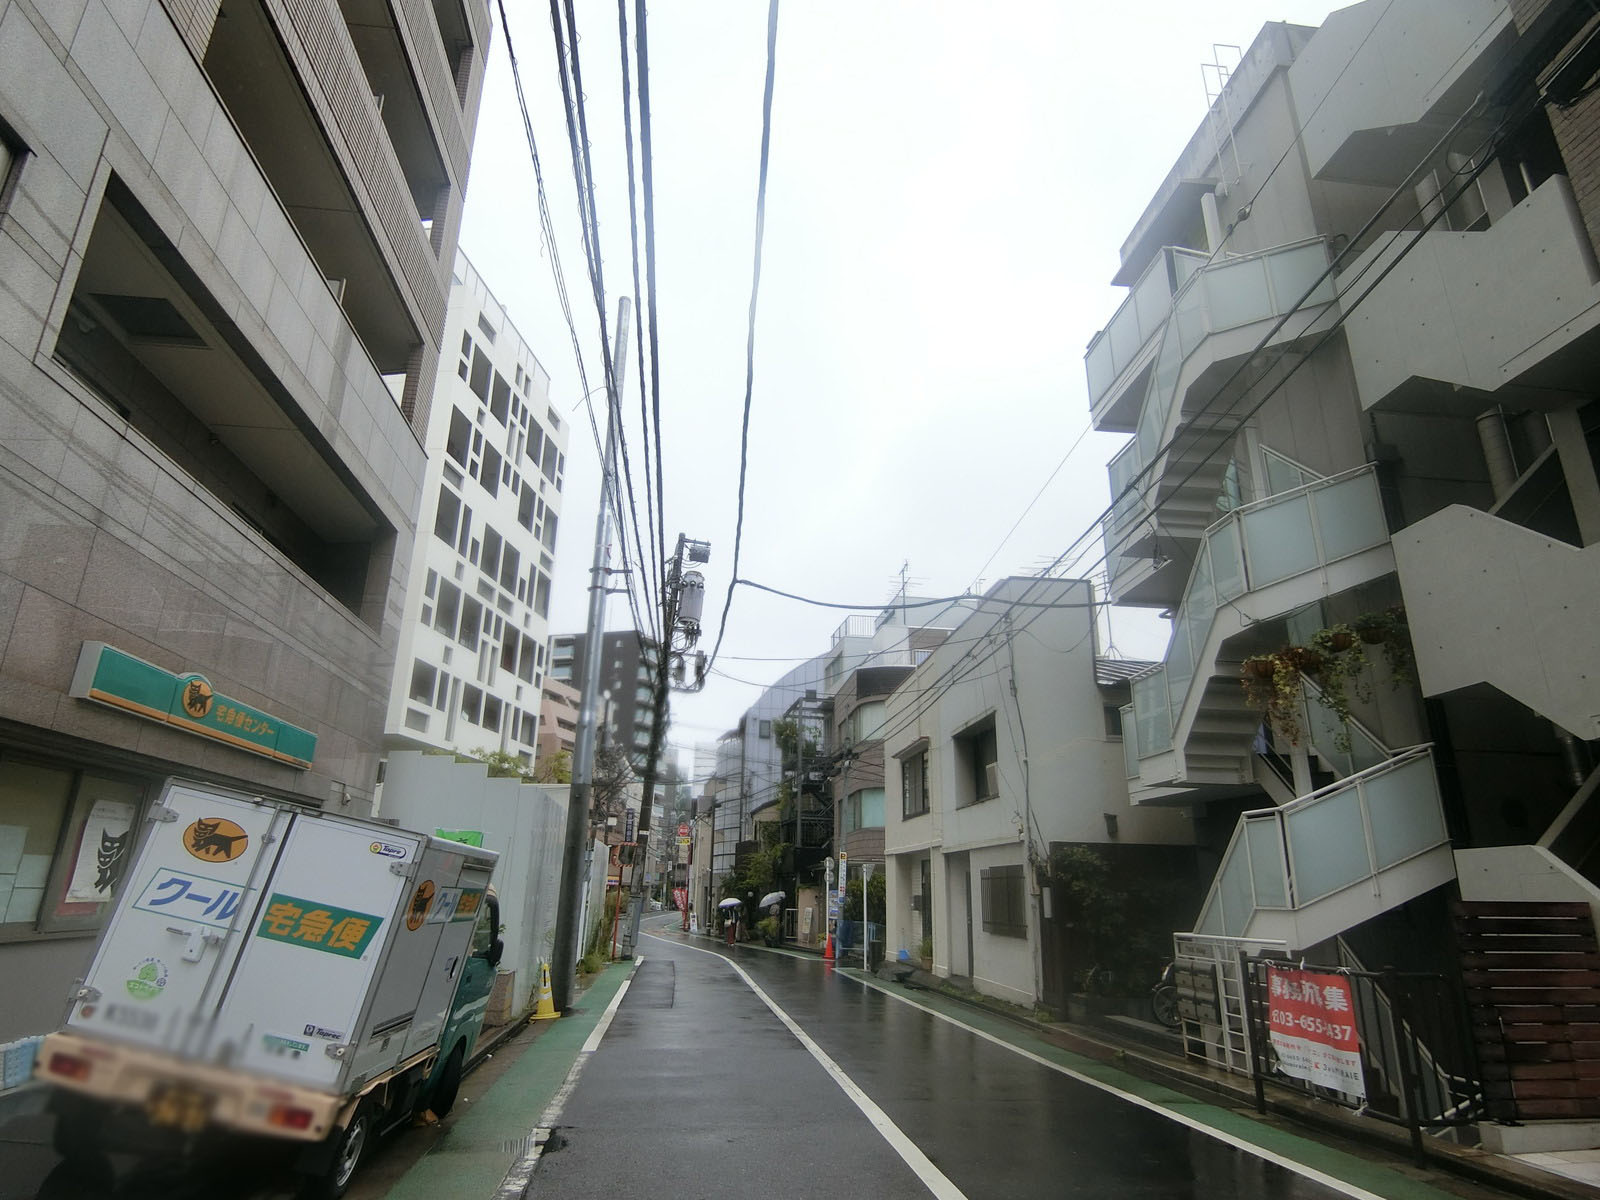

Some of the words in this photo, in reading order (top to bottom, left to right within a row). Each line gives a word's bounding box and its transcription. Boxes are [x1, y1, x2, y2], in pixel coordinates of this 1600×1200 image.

[216, 704, 274, 736] 宅急便センター
[149, 877, 240, 920] クール
[264, 902, 371, 951] 宅急便
